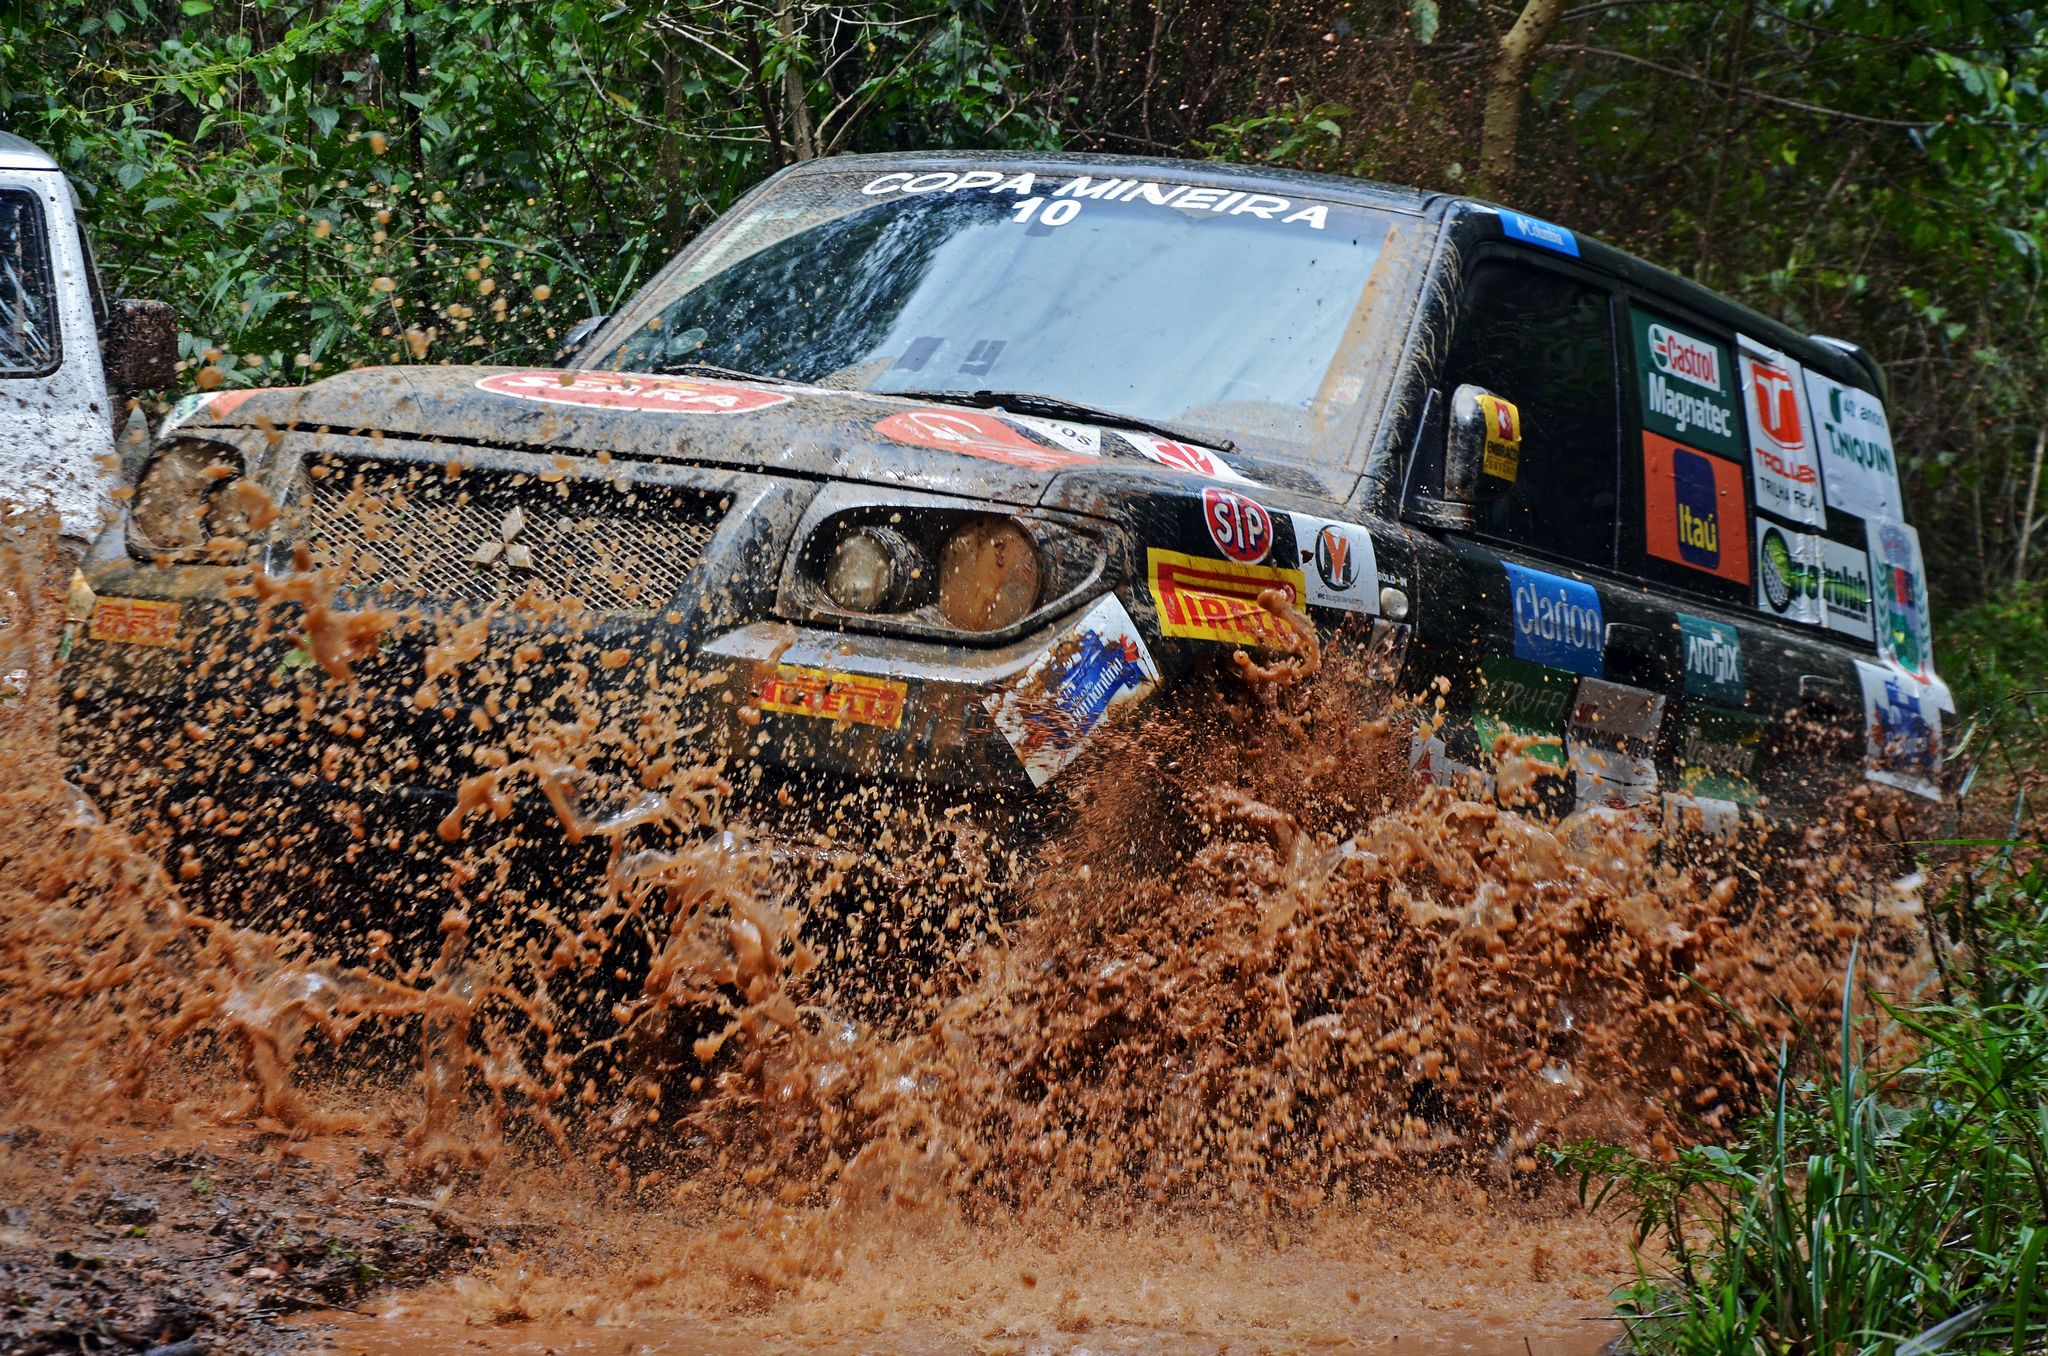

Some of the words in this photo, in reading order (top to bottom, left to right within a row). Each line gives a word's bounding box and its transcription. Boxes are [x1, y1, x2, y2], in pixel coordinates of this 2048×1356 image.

[862, 170, 1037, 196] COPA
[1057, 176, 1329, 230] MINEIRA
[1011, 196, 1083, 226] 10
[1667, 334, 1716, 385] Castrol
[1648, 372, 1732, 438] Magnatec
[1214, 493, 1264, 549] STP
[1679, 504, 1717, 553] Itaú
[1157, 562, 1299, 642] PIRELL
[1515, 583, 1600, 650] Clarion
